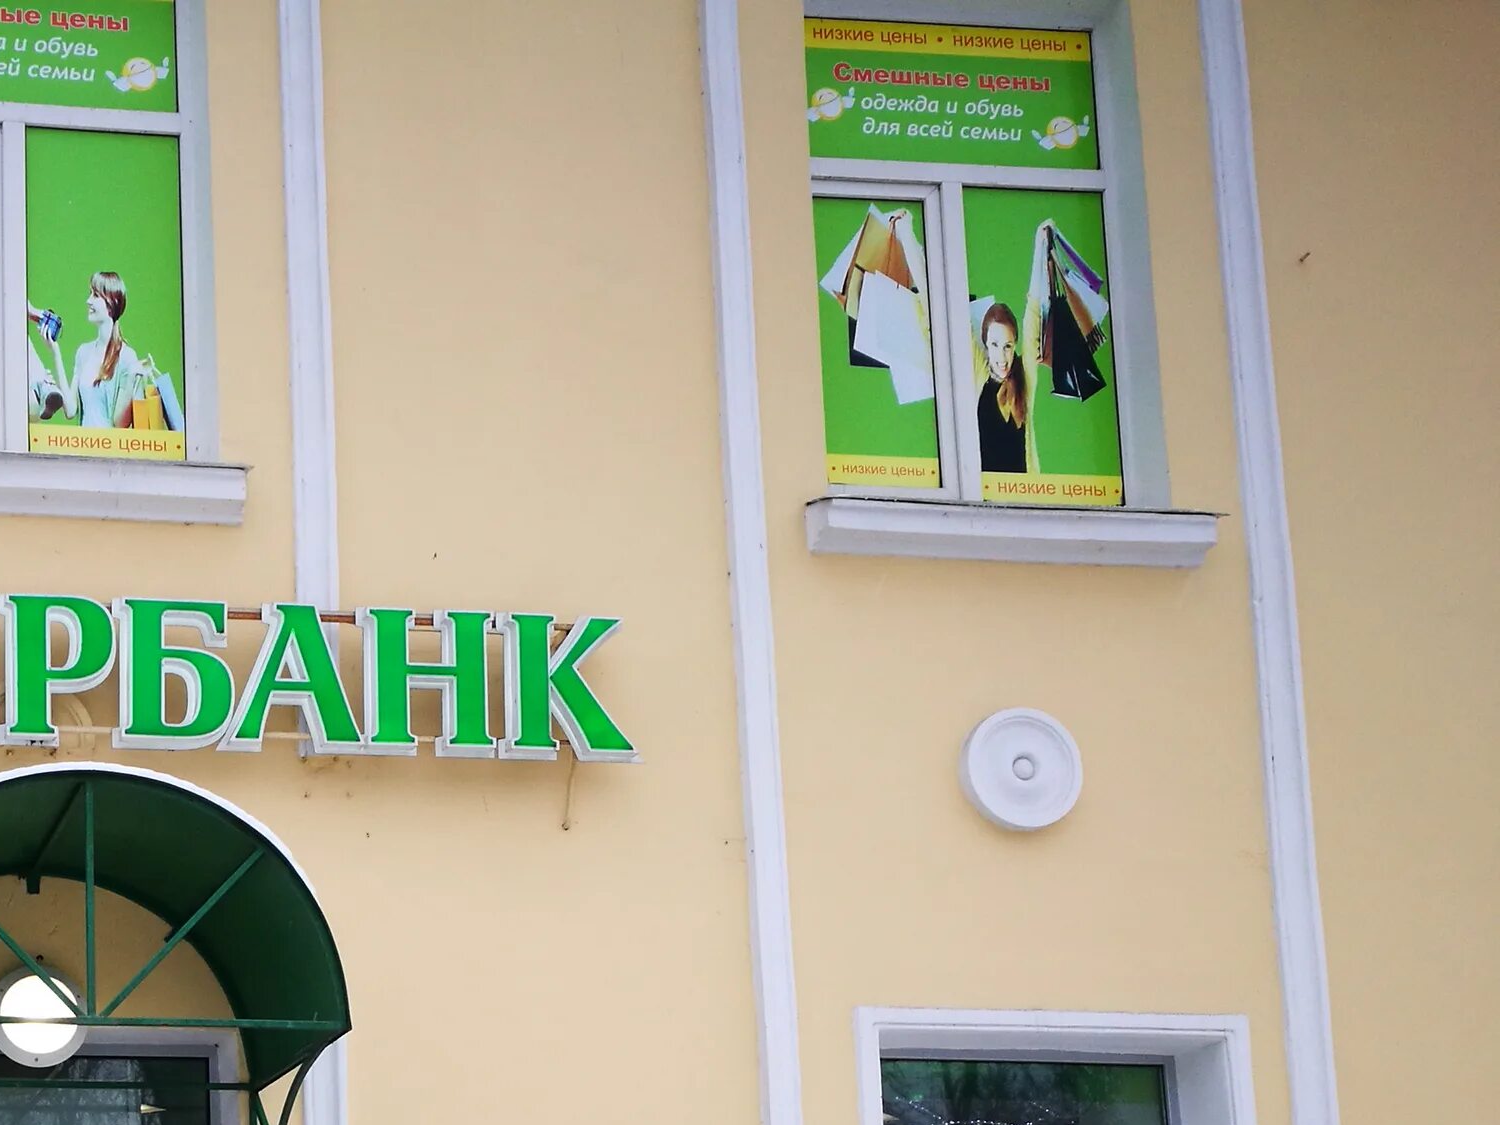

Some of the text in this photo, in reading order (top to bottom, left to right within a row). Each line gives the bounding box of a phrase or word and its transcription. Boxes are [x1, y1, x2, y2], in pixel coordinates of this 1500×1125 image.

[51, 11, 130, 32] цены
[14, 36, 28, 51] и
[35, 32, 99, 59] обувь
[812, 27, 1066, 52] низкие цены низкие цены
[28, 64, 95, 82] семьи
[832, 62, 1051, 92] Смешные цены
[860, 93, 1024, 121] одежда и обувь
[862, 116, 1022, 142] для всей семьи
[48, 436, 168, 452] низкие цены
[842, 464, 925, 478] низкие цены
[997, 482, 1107, 497] низкие цены
